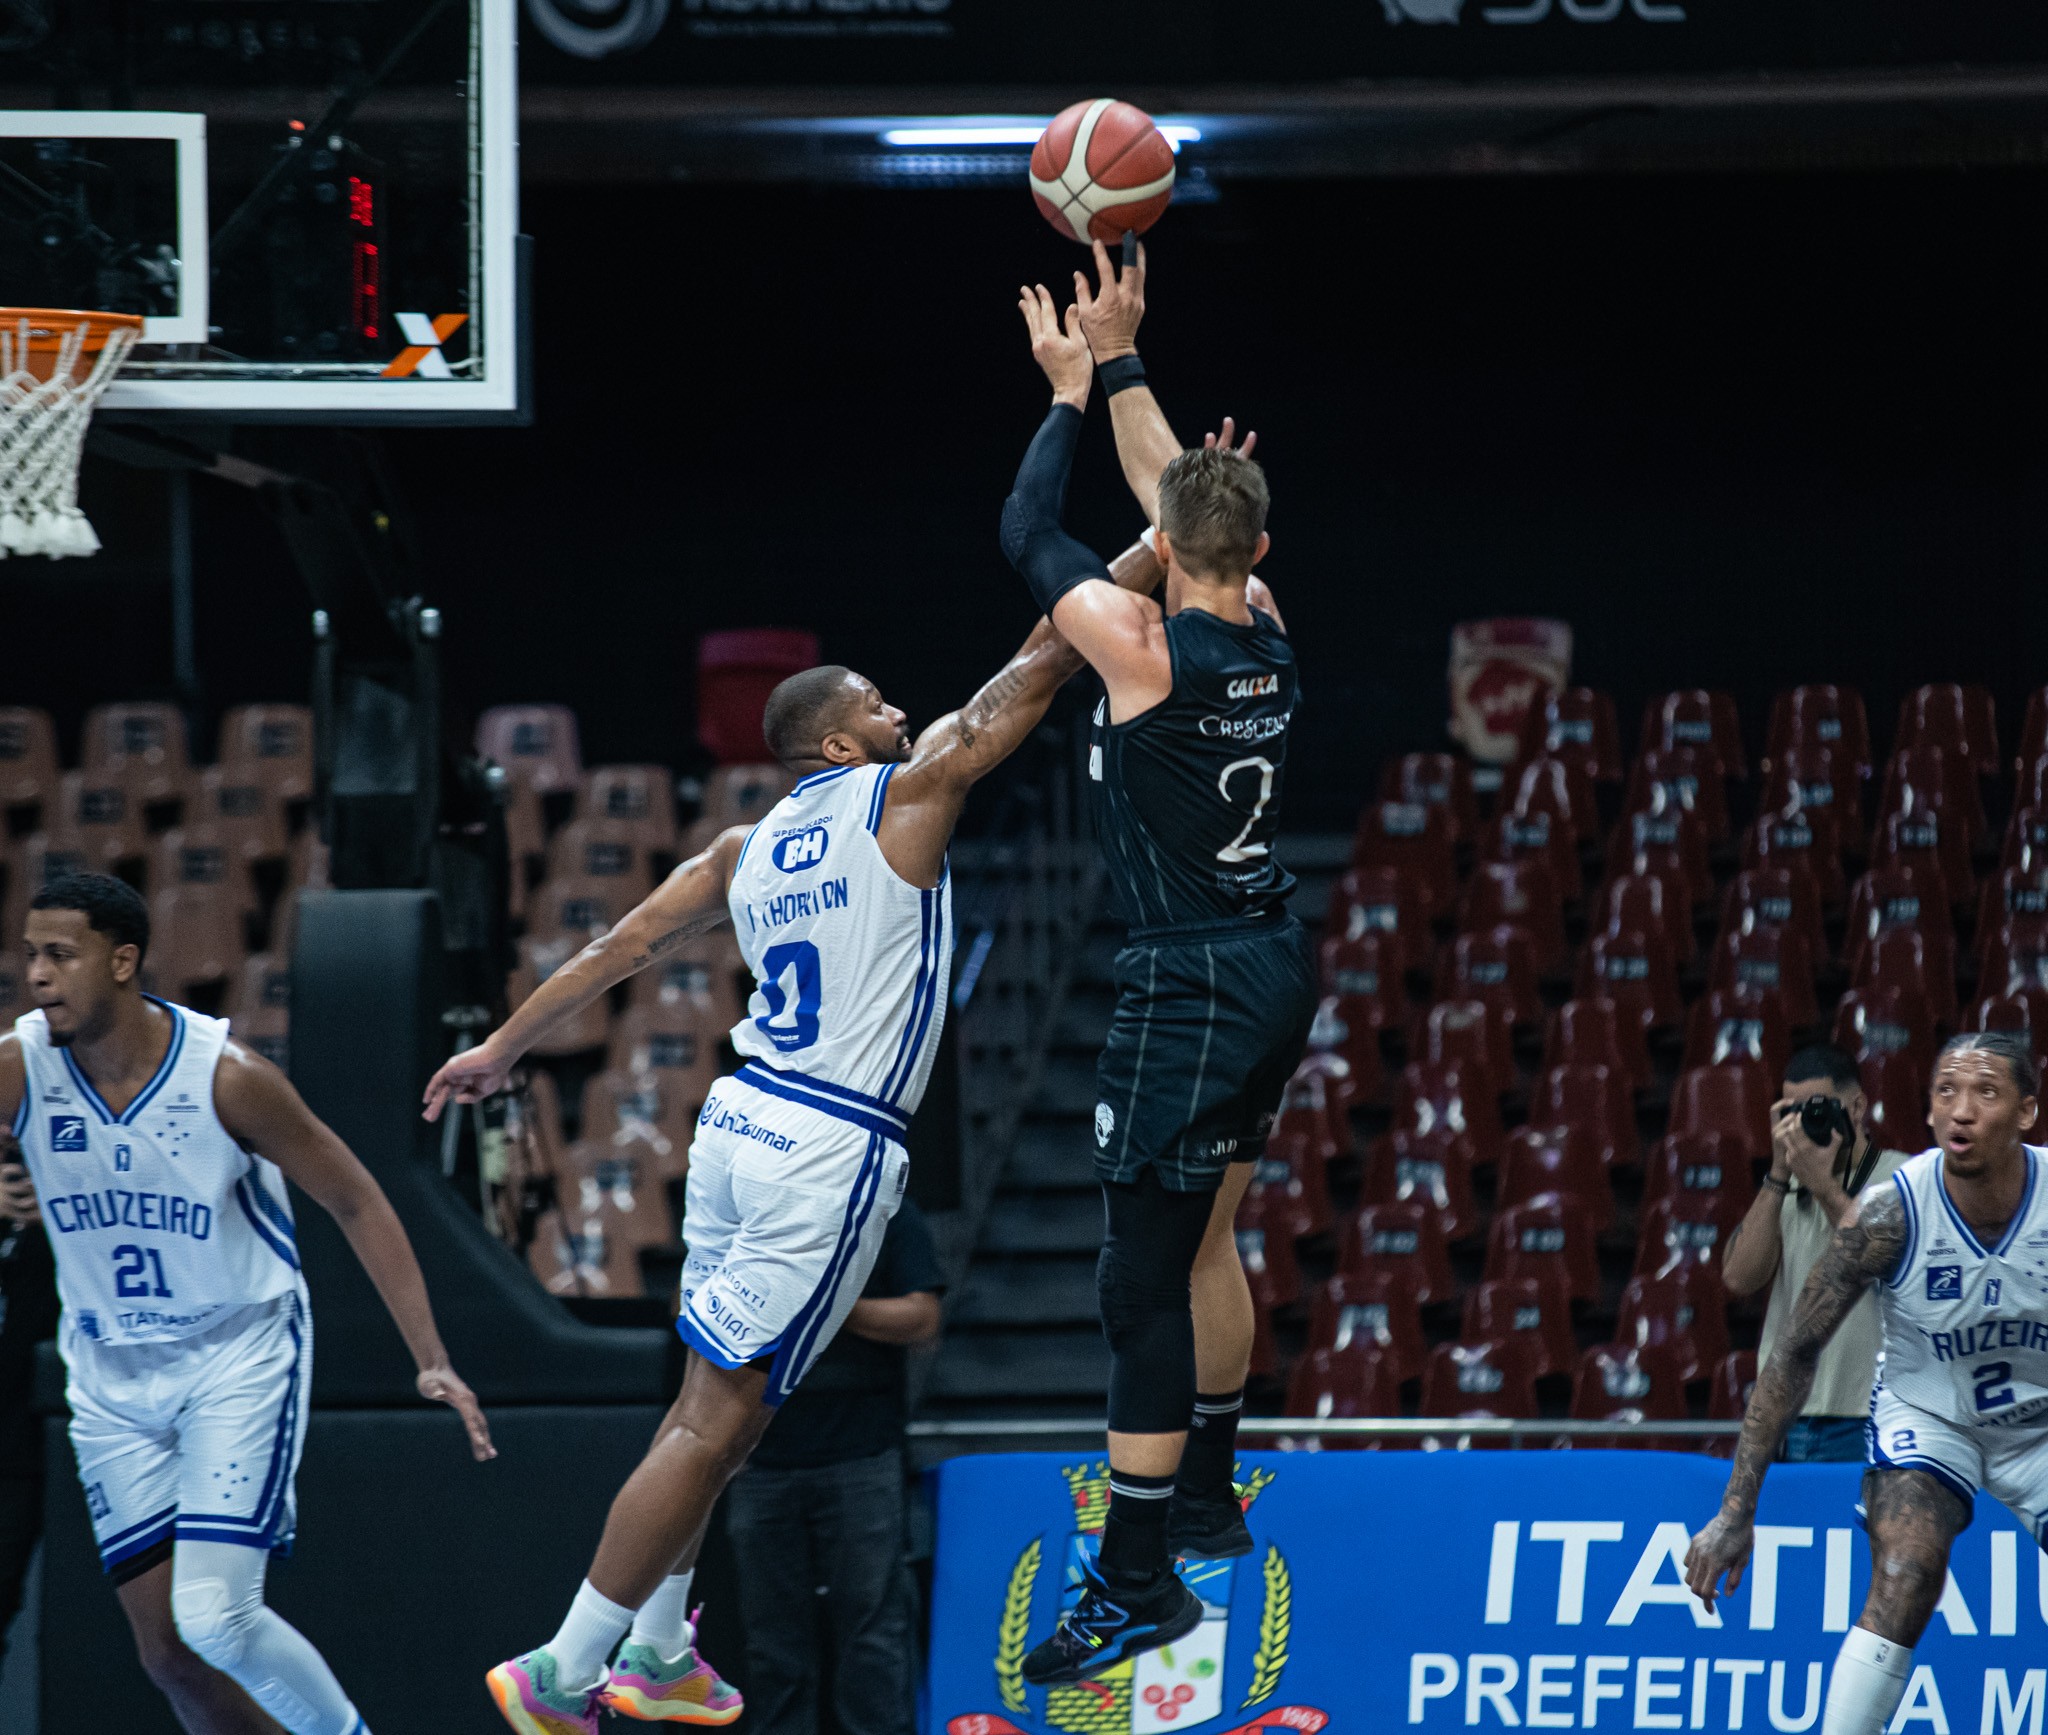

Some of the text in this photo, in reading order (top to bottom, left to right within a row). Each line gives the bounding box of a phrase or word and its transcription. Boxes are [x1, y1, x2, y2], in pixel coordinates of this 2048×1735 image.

[1227, 674, 1278, 699] CAIXA
[1216, 756, 1275, 862] 2
[782, 830, 824, 869] BH
[48, 1189, 212, 1240] CRUZEIRO
[113, 1244, 173, 1298] 21
[1916, 1319, 2048, 1362] RUZEIR
[1972, 1361, 2016, 1412] 2
[1892, 1429, 1918, 1452] 2
[1484, 1520, 2048, 1637] ITATII
[1408, 1652, 1950, 1735] PREFEITUA
